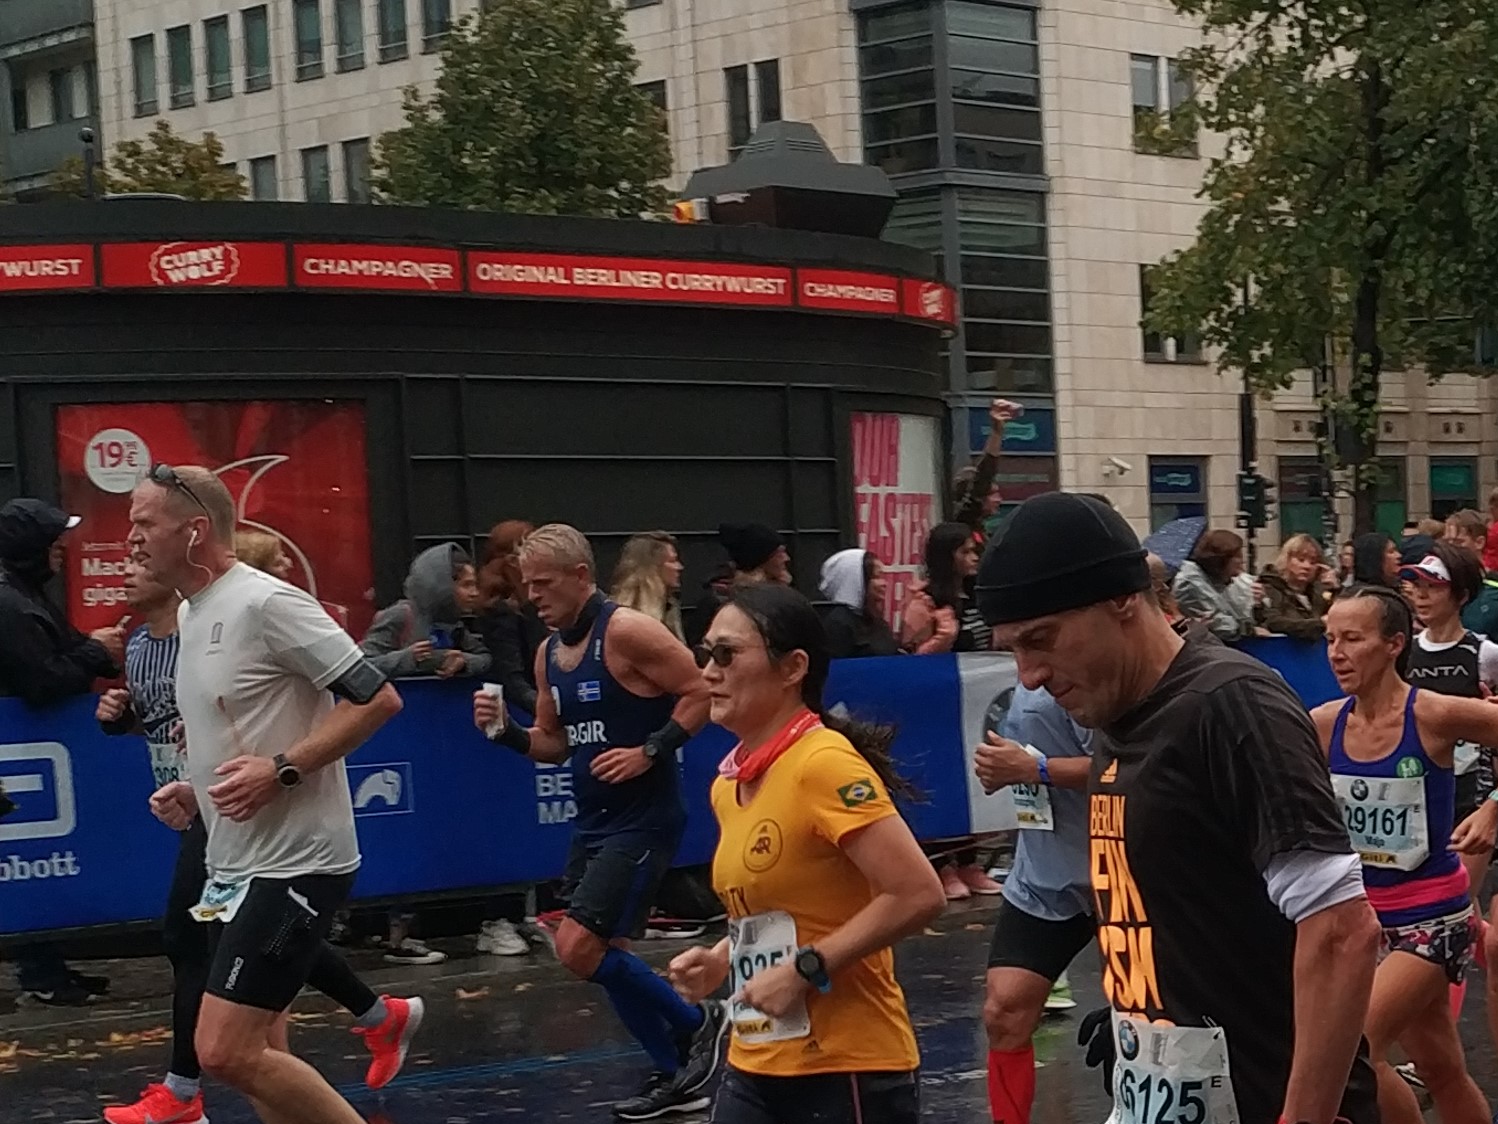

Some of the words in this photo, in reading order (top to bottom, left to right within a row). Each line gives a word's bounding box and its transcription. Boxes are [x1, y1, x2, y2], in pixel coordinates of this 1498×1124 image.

[159, 246, 225, 270] CURRY
[166, 260, 226, 284] WOLF
[303, 258, 454, 290] CHAMPAGNER
[475, 262, 570, 286] ORIGINAL
[573, 267, 663, 290] BERLINER
[666, 272, 786, 296] CURRYWURST
[803, 282, 897, 304] CHAMPAGNER
[92, 441, 123, 469] 19
[1408, 665, 1469, 679] ANTA
[1090, 794, 1126, 839] BERLIN
[1344, 804, 1409, 836] 29161
[1211, 1075, 1223, 1088] E
